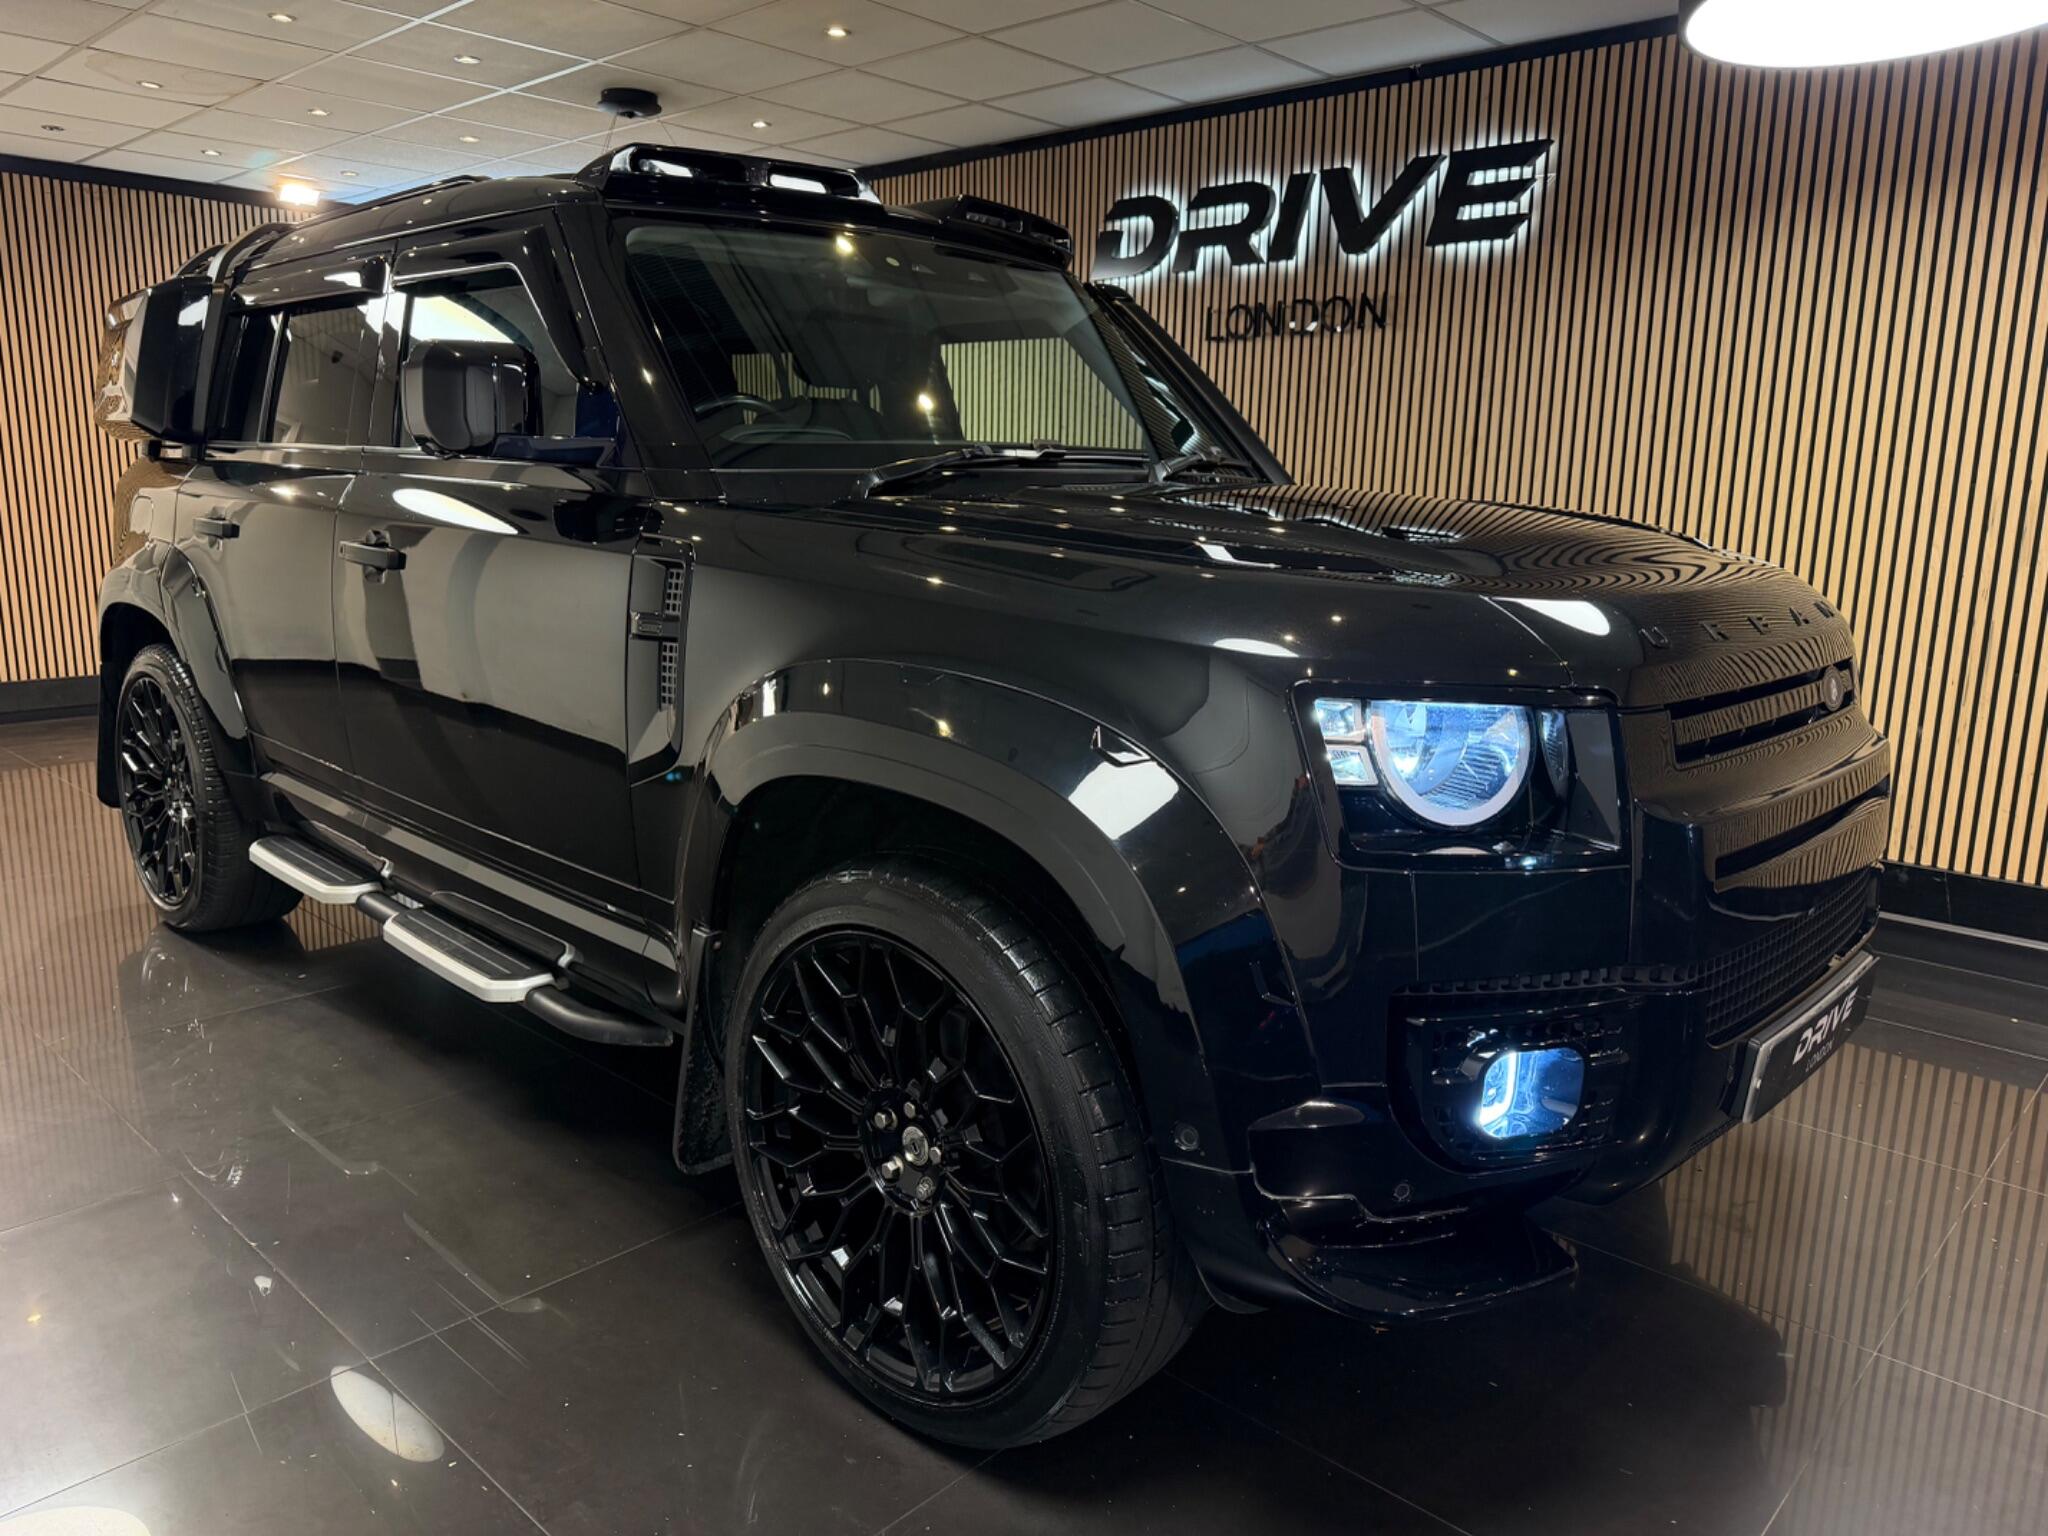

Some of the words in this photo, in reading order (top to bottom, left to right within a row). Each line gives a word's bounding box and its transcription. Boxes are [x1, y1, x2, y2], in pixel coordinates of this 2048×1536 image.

[1090, 138, 1554, 281] DRIVE
[1204, 291, 1388, 343] LONDON
[1793, 987, 1859, 1064] DRIVE
